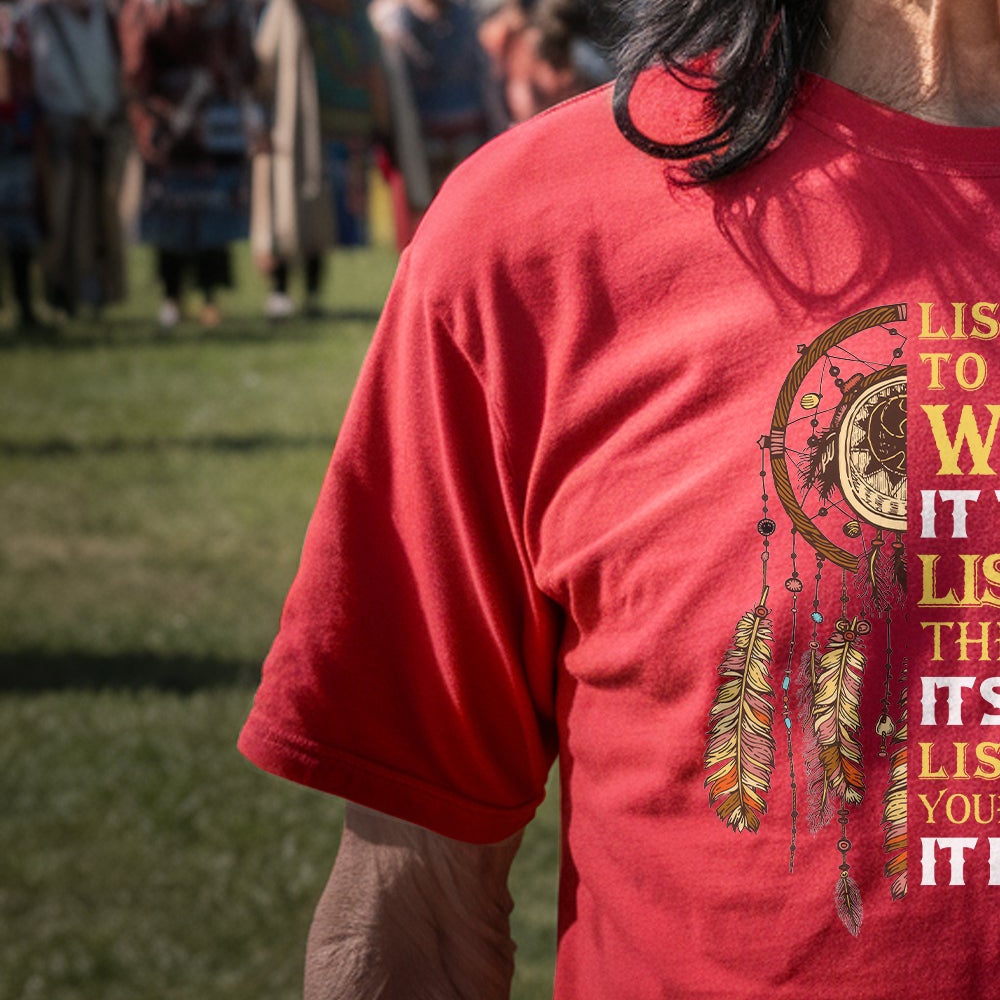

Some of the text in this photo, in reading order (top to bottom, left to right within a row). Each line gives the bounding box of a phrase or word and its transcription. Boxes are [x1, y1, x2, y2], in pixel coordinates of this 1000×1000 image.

[921, 352, 987, 391] TO
[920, 490, 978, 538] IT
[920, 677, 976, 725] IT
[920, 837, 978, 885] IT
